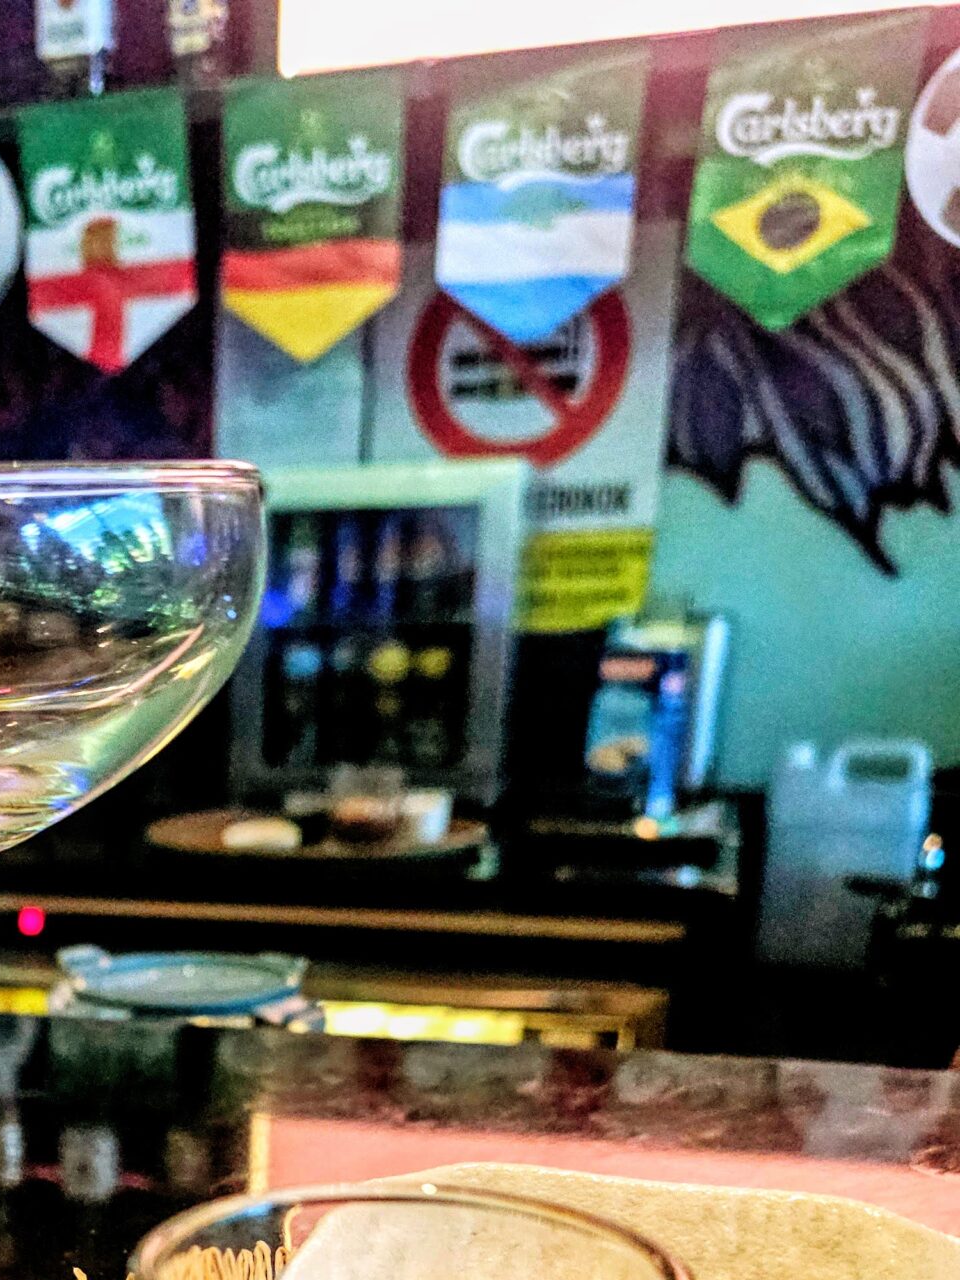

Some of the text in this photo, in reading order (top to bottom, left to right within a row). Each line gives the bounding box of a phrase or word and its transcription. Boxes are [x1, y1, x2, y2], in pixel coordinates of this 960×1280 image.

[458, 114, 628, 189] Carlsberg
[716, 90, 898, 165] Carlsberg
[30, 153, 179, 230] Carlsberg
[233, 135, 390, 213] Carlsberg
